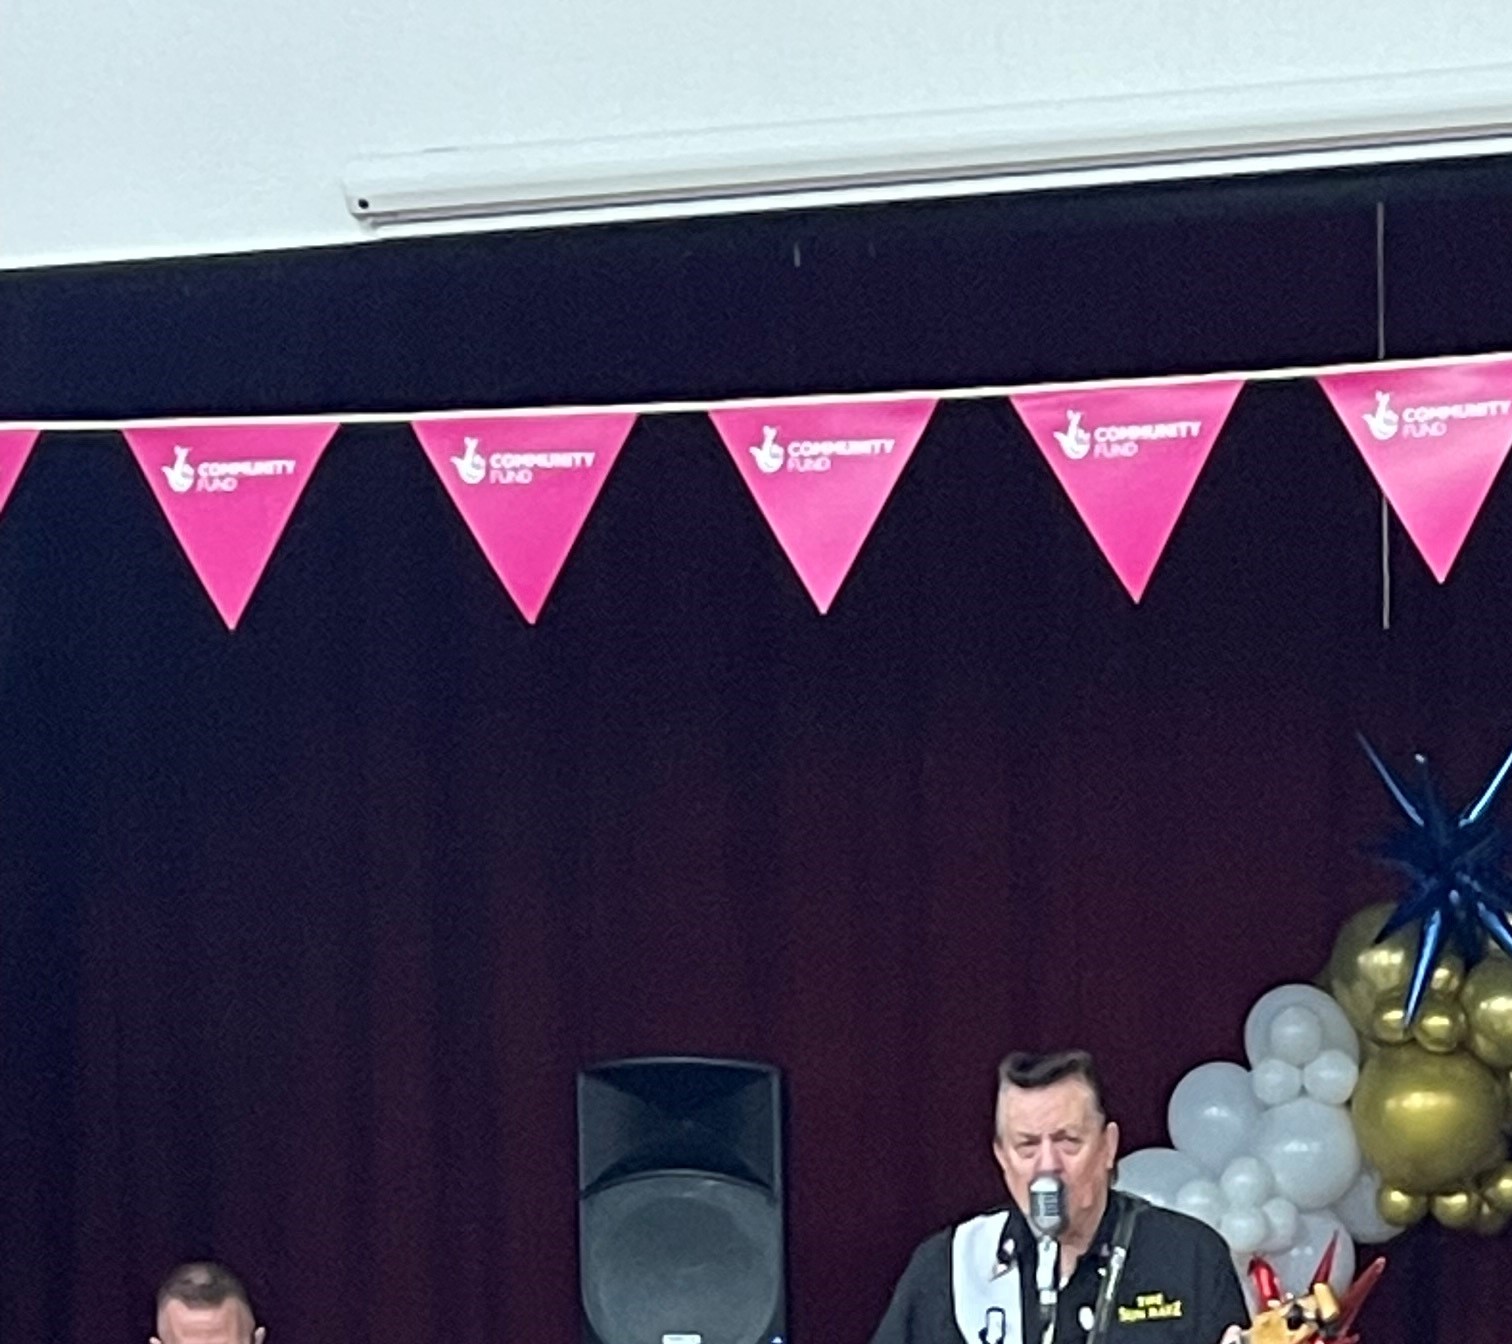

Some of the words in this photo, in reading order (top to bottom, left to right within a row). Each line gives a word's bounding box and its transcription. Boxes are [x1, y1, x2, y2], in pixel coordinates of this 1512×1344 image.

[1403, 399, 1512, 422] COMMUNITY
[1094, 421, 1201, 442] COMMUNITY
[1403, 420, 1447, 438] FUND
[787, 438, 895, 457] COMMUNITY
[1094, 441, 1139, 458] FUND
[198, 459, 295, 478] COMMUNITY
[489, 451, 595, 470] COMMUNITY
[787, 457, 831, 473] FUND
[197, 477, 237, 492] FUND
[490, 469, 532, 484] FUND
